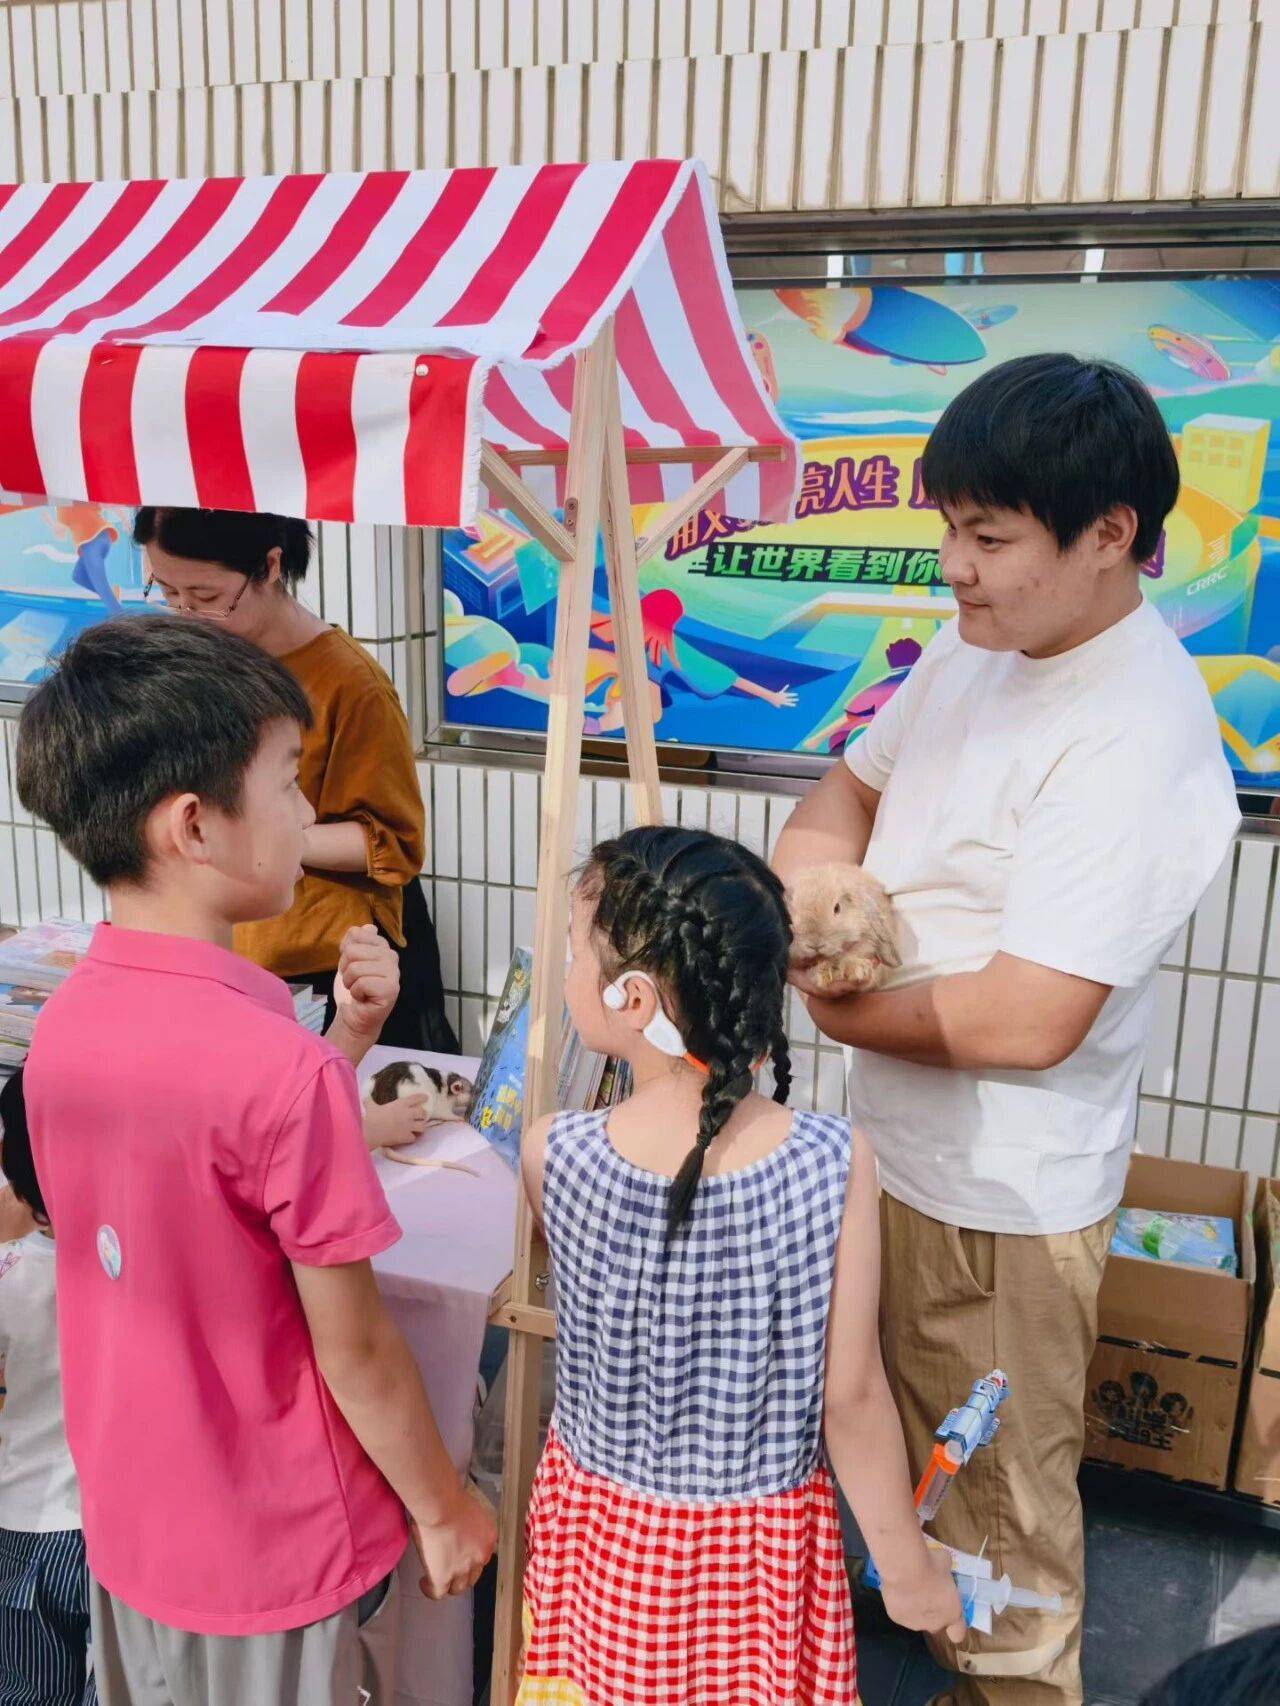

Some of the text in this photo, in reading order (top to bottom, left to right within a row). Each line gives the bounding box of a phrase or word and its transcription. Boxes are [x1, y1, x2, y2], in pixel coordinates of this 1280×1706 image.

[711, 544, 943, 584] 让世界看到你
[1186, 564, 1229, 596] CRRC
